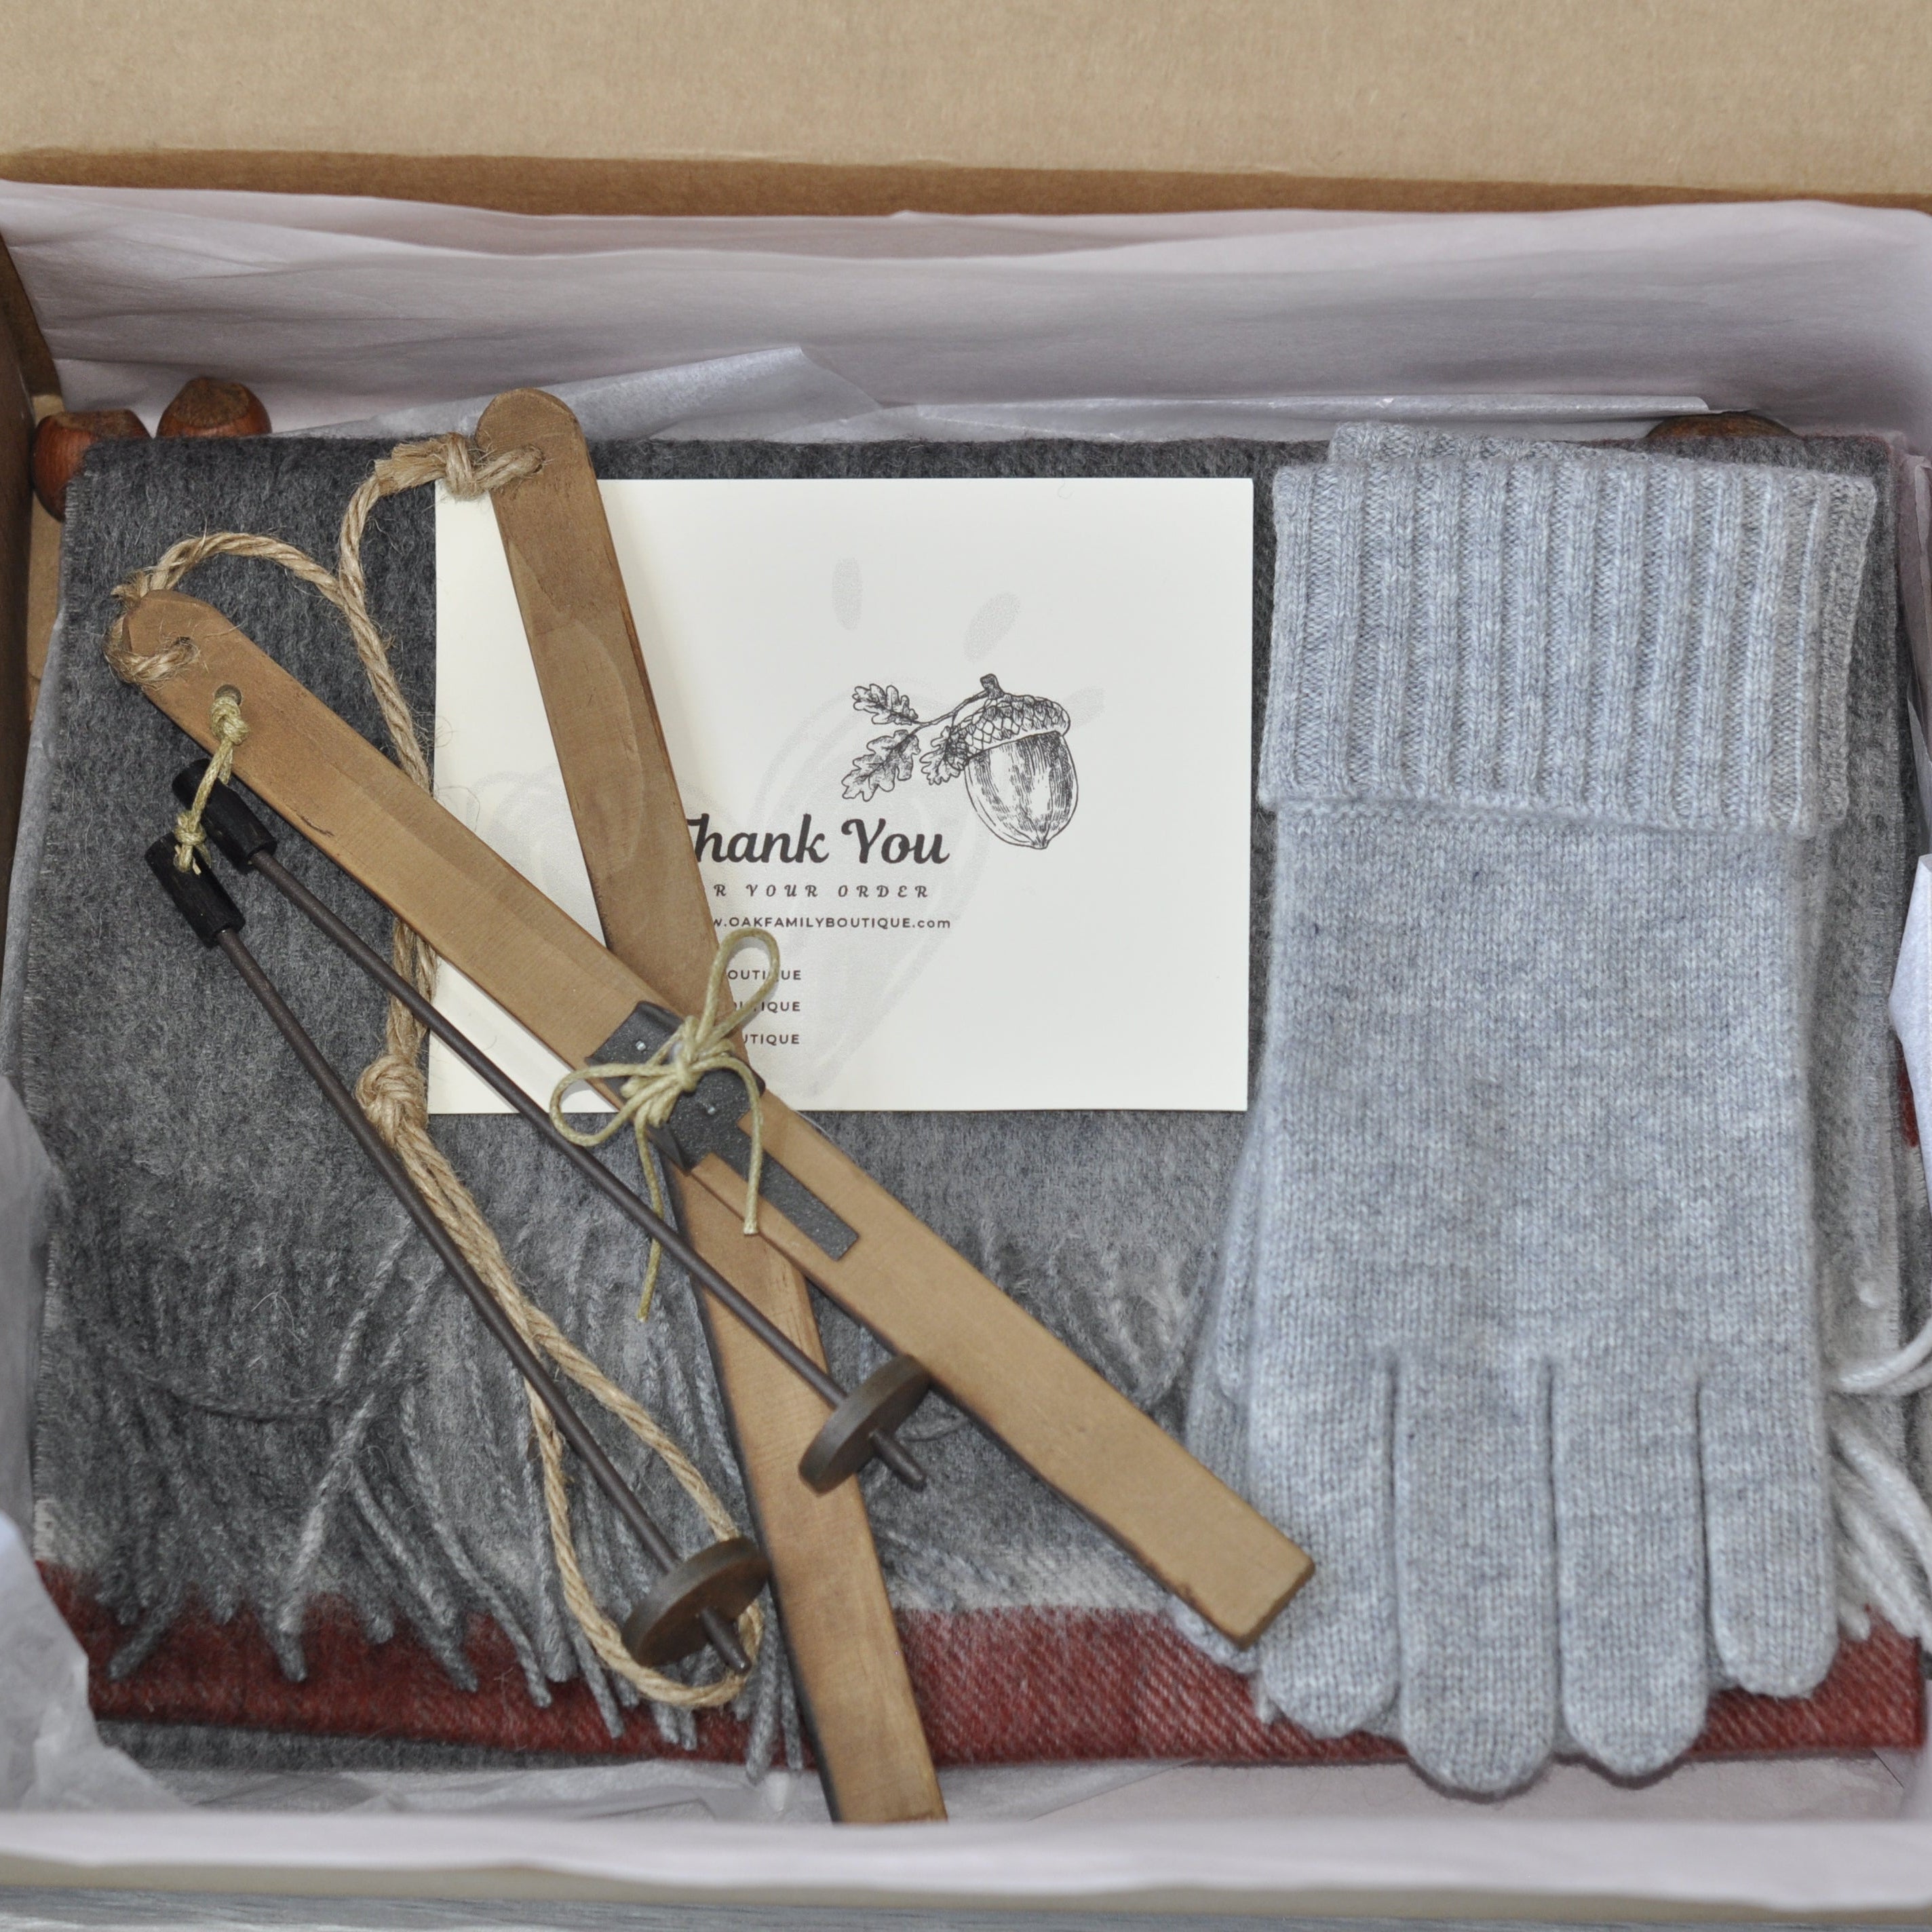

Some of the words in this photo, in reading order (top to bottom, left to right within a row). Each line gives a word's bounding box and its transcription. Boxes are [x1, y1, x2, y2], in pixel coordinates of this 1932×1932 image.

[841, 817, 950, 864] You
[746, 884, 818, 897] YOUR
[838, 885, 928, 898] ORDER
[713, 916, 951, 930] w.OAKFAMILYBOUTIQUE.com
[727, 969, 802, 980] OUTIUE
